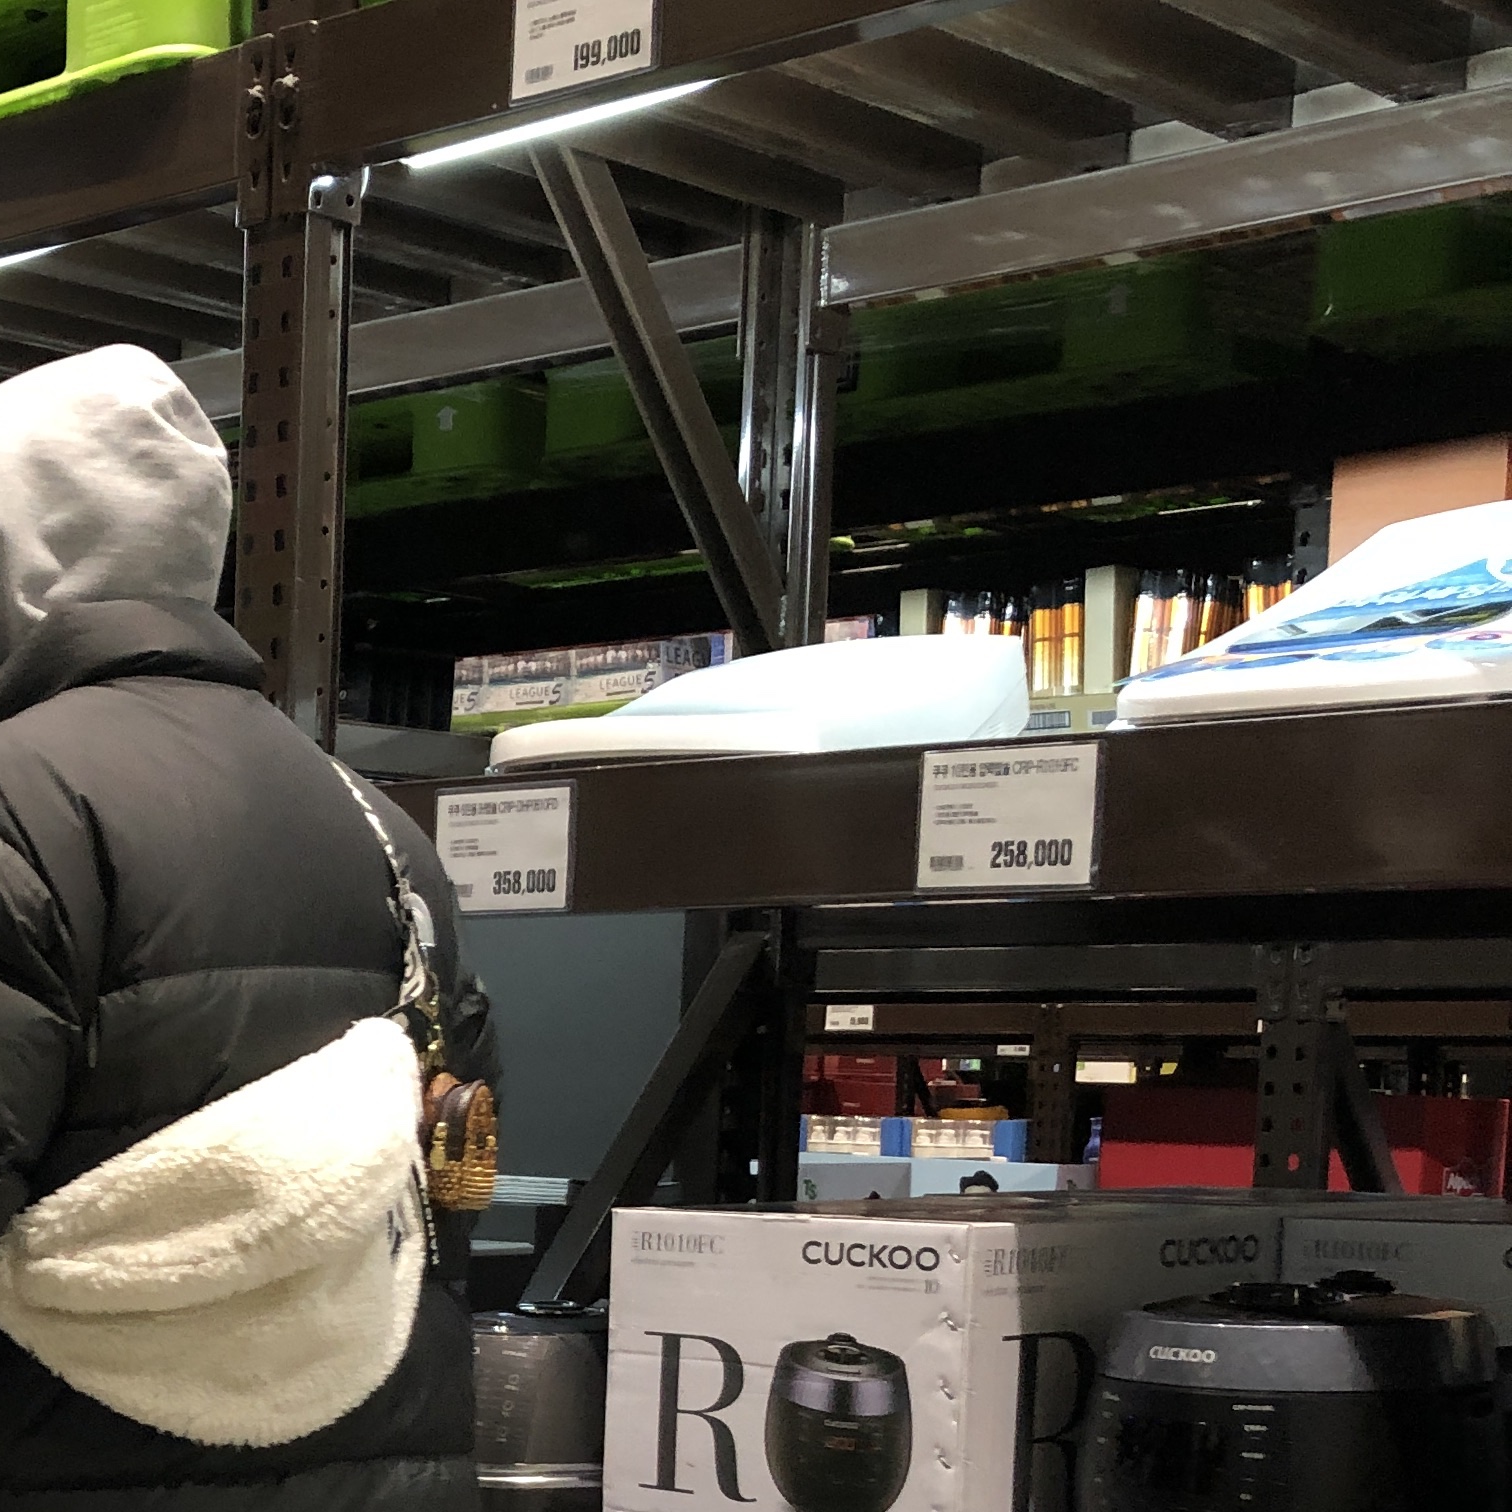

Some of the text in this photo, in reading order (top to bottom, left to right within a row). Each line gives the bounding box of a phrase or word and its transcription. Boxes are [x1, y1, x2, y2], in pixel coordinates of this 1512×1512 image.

[573, 28, 641, 71] 199,000
[508, 682, 563, 706] LEAGUE 5
[598, 670, 656, 694] LEAGUE 5
[990, 838, 1074, 869] 258,000
[492, 868, 556, 896] 358,000
[640, 1230, 726, 1256] R1010FC
[801, 1239, 941, 1272] CUCKOO
[1159, 1233, 1261, 1268] CUCKOO
[1149, 1345, 1217, 1364] CUCKOO
[638, 1331, 758, 1503] R
